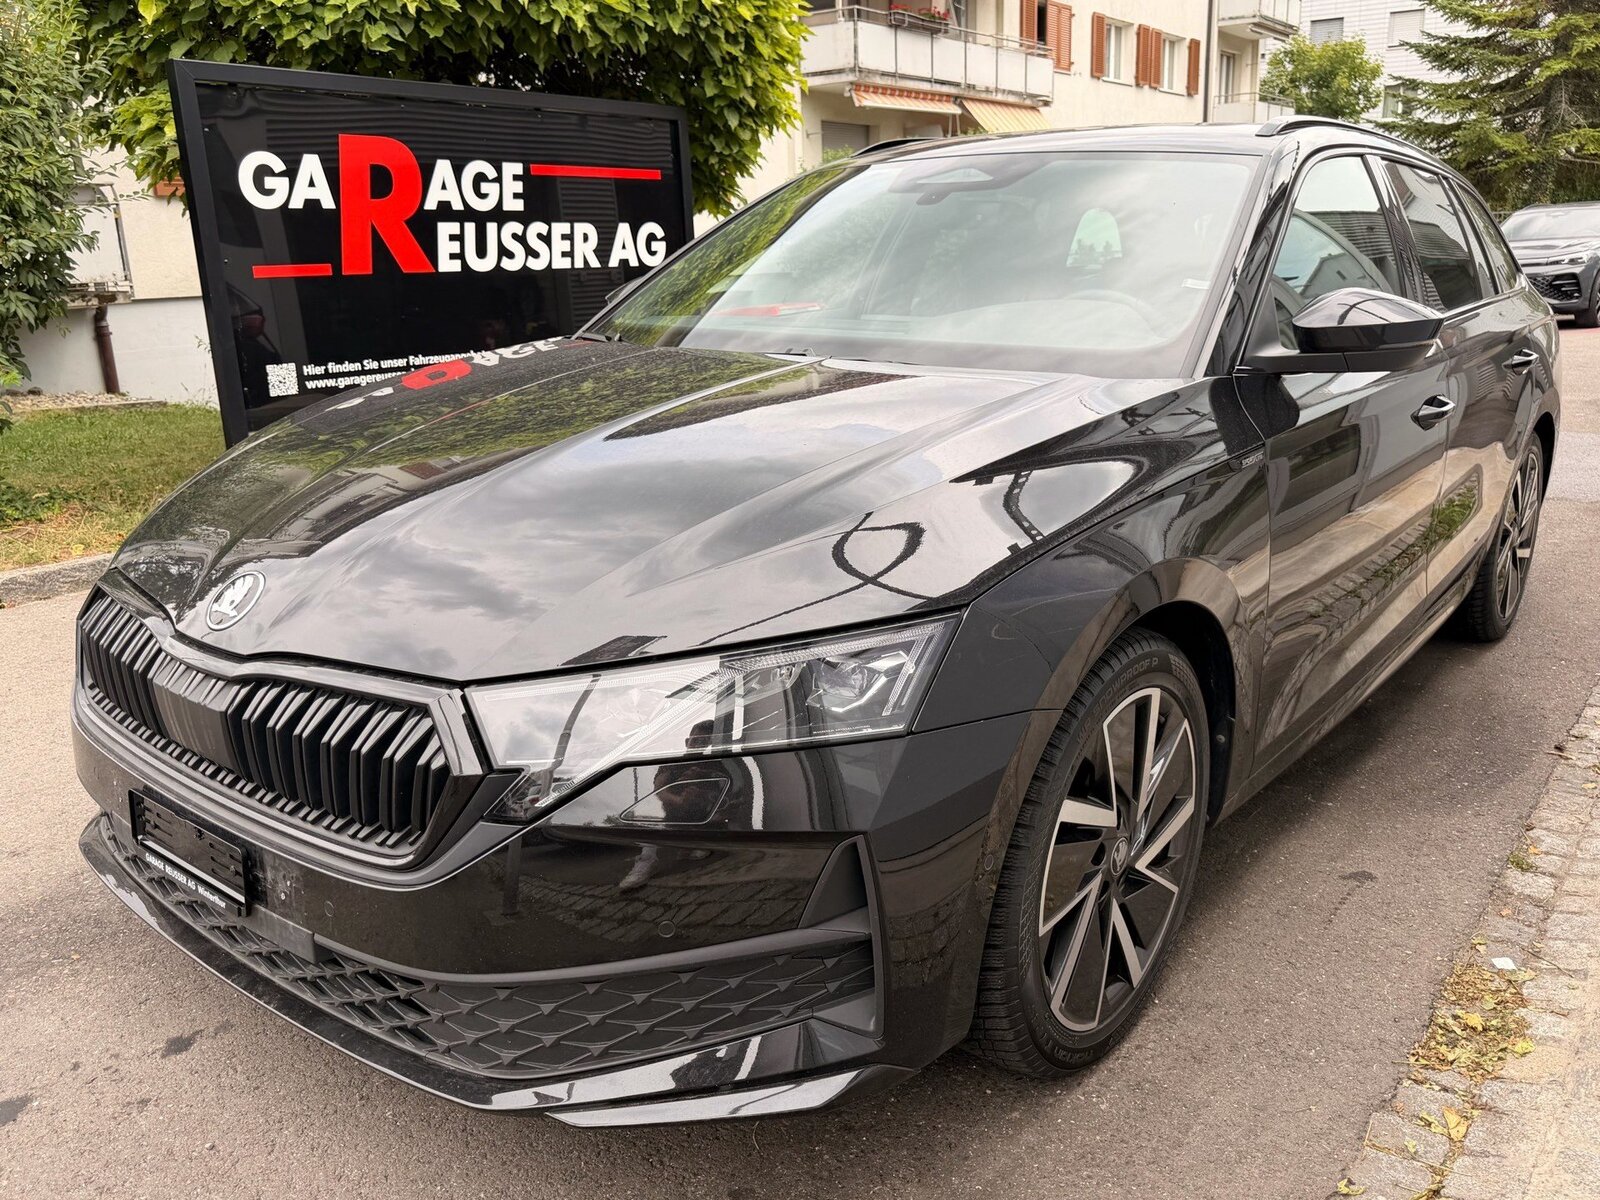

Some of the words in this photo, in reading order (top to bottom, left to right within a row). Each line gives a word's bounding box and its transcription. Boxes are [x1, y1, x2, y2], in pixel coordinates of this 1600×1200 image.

[238, 133, 525, 275] GARAGE
[608, 222, 667, 267] AG
[303, 364, 326, 376] Hier
[327, 361, 362, 374] finden
[362, 359, 379, 370] Sie
[380, 356, 408, 368] unser
[146, 853, 165, 871] GARAGE
[165, 865, 188, 885] REUSSER
[187, 880, 196, 890] AG
[197, 884, 226, 909] Winterthur
